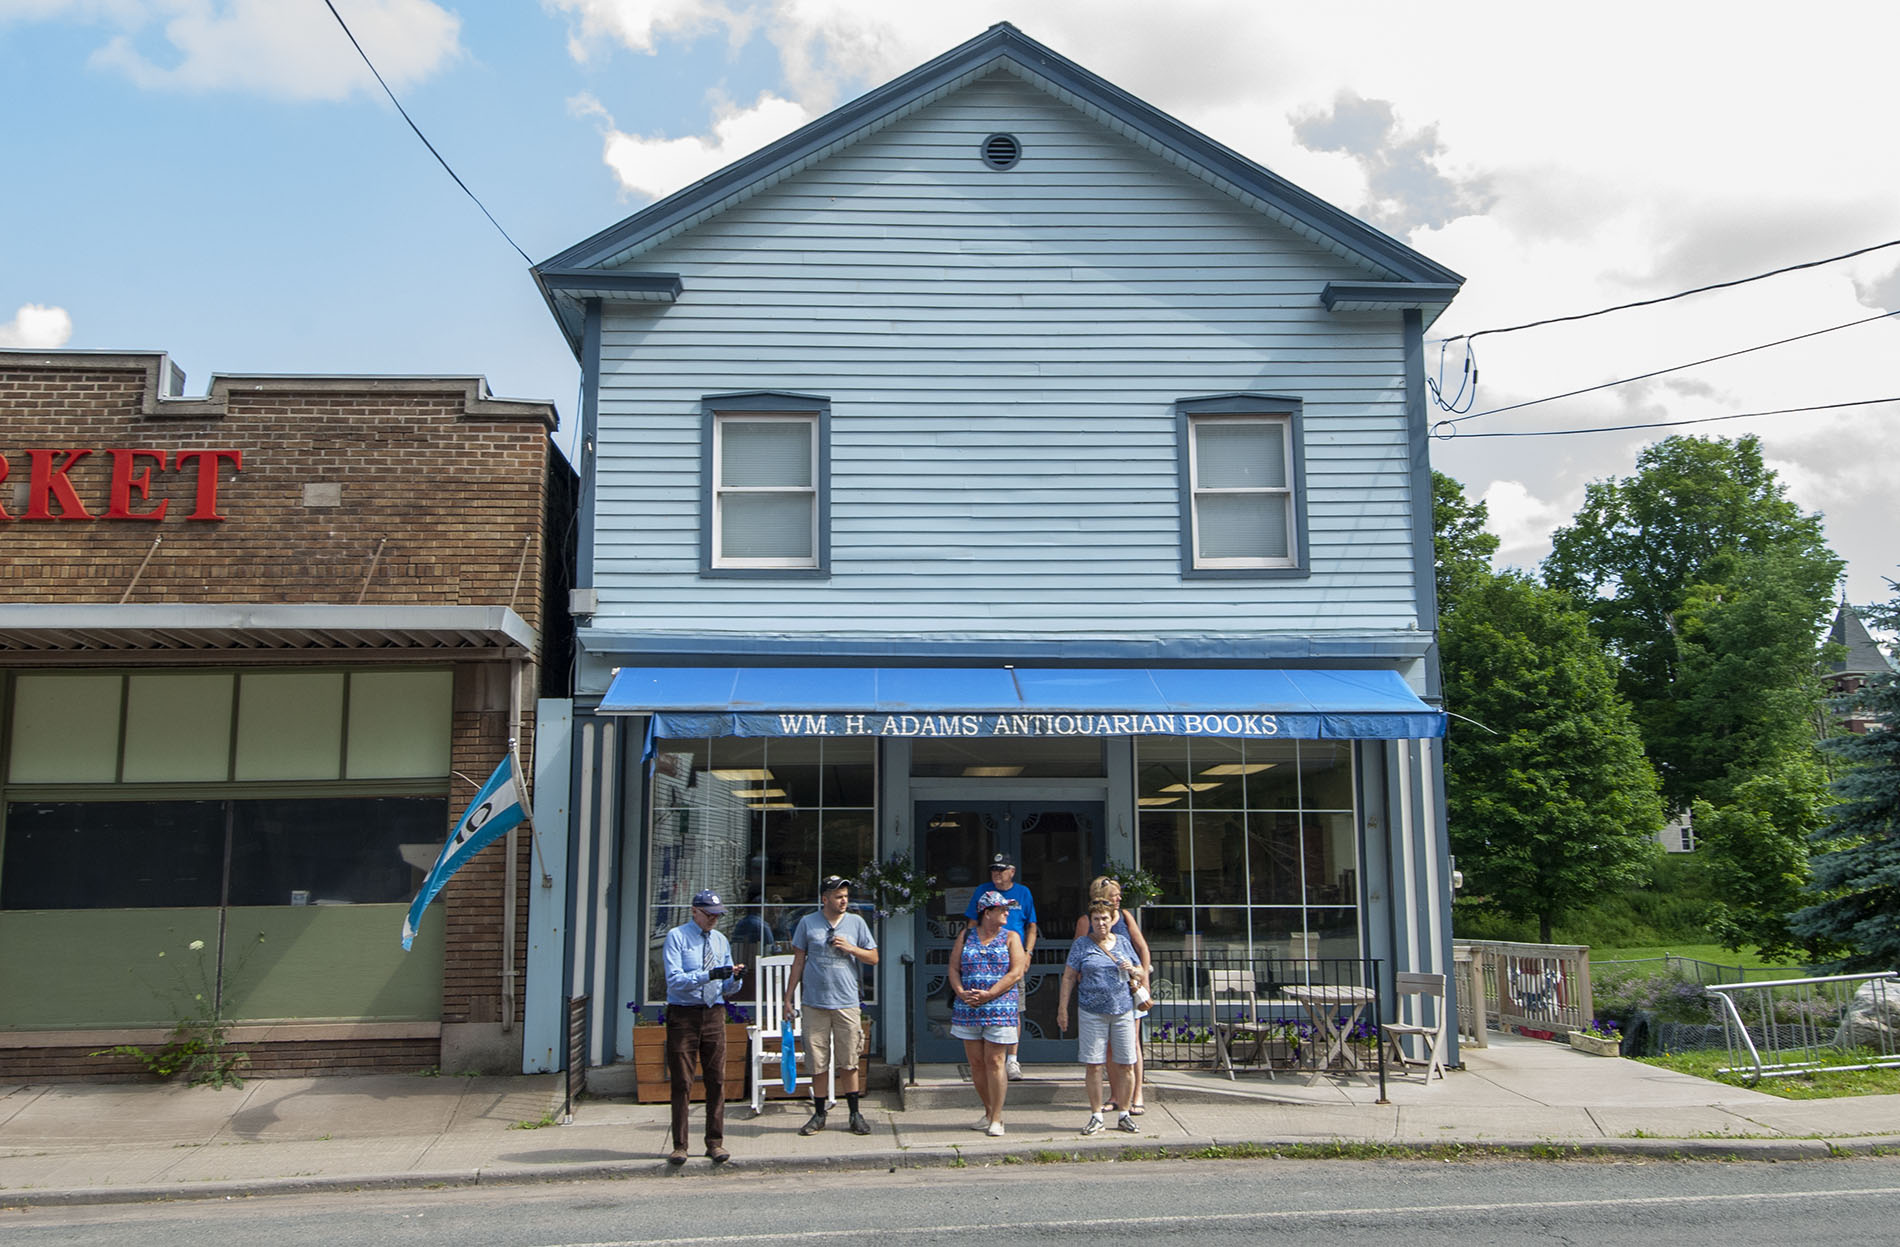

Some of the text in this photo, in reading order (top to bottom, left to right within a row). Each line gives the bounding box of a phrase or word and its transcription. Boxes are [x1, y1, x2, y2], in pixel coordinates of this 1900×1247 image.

[0, 449, 242, 521] KET
[779, 714, 1278, 736] WM. H. ADAMS' ANTIQUARIAN BOOKS
[1152, 990, 1172, 1000] 602
